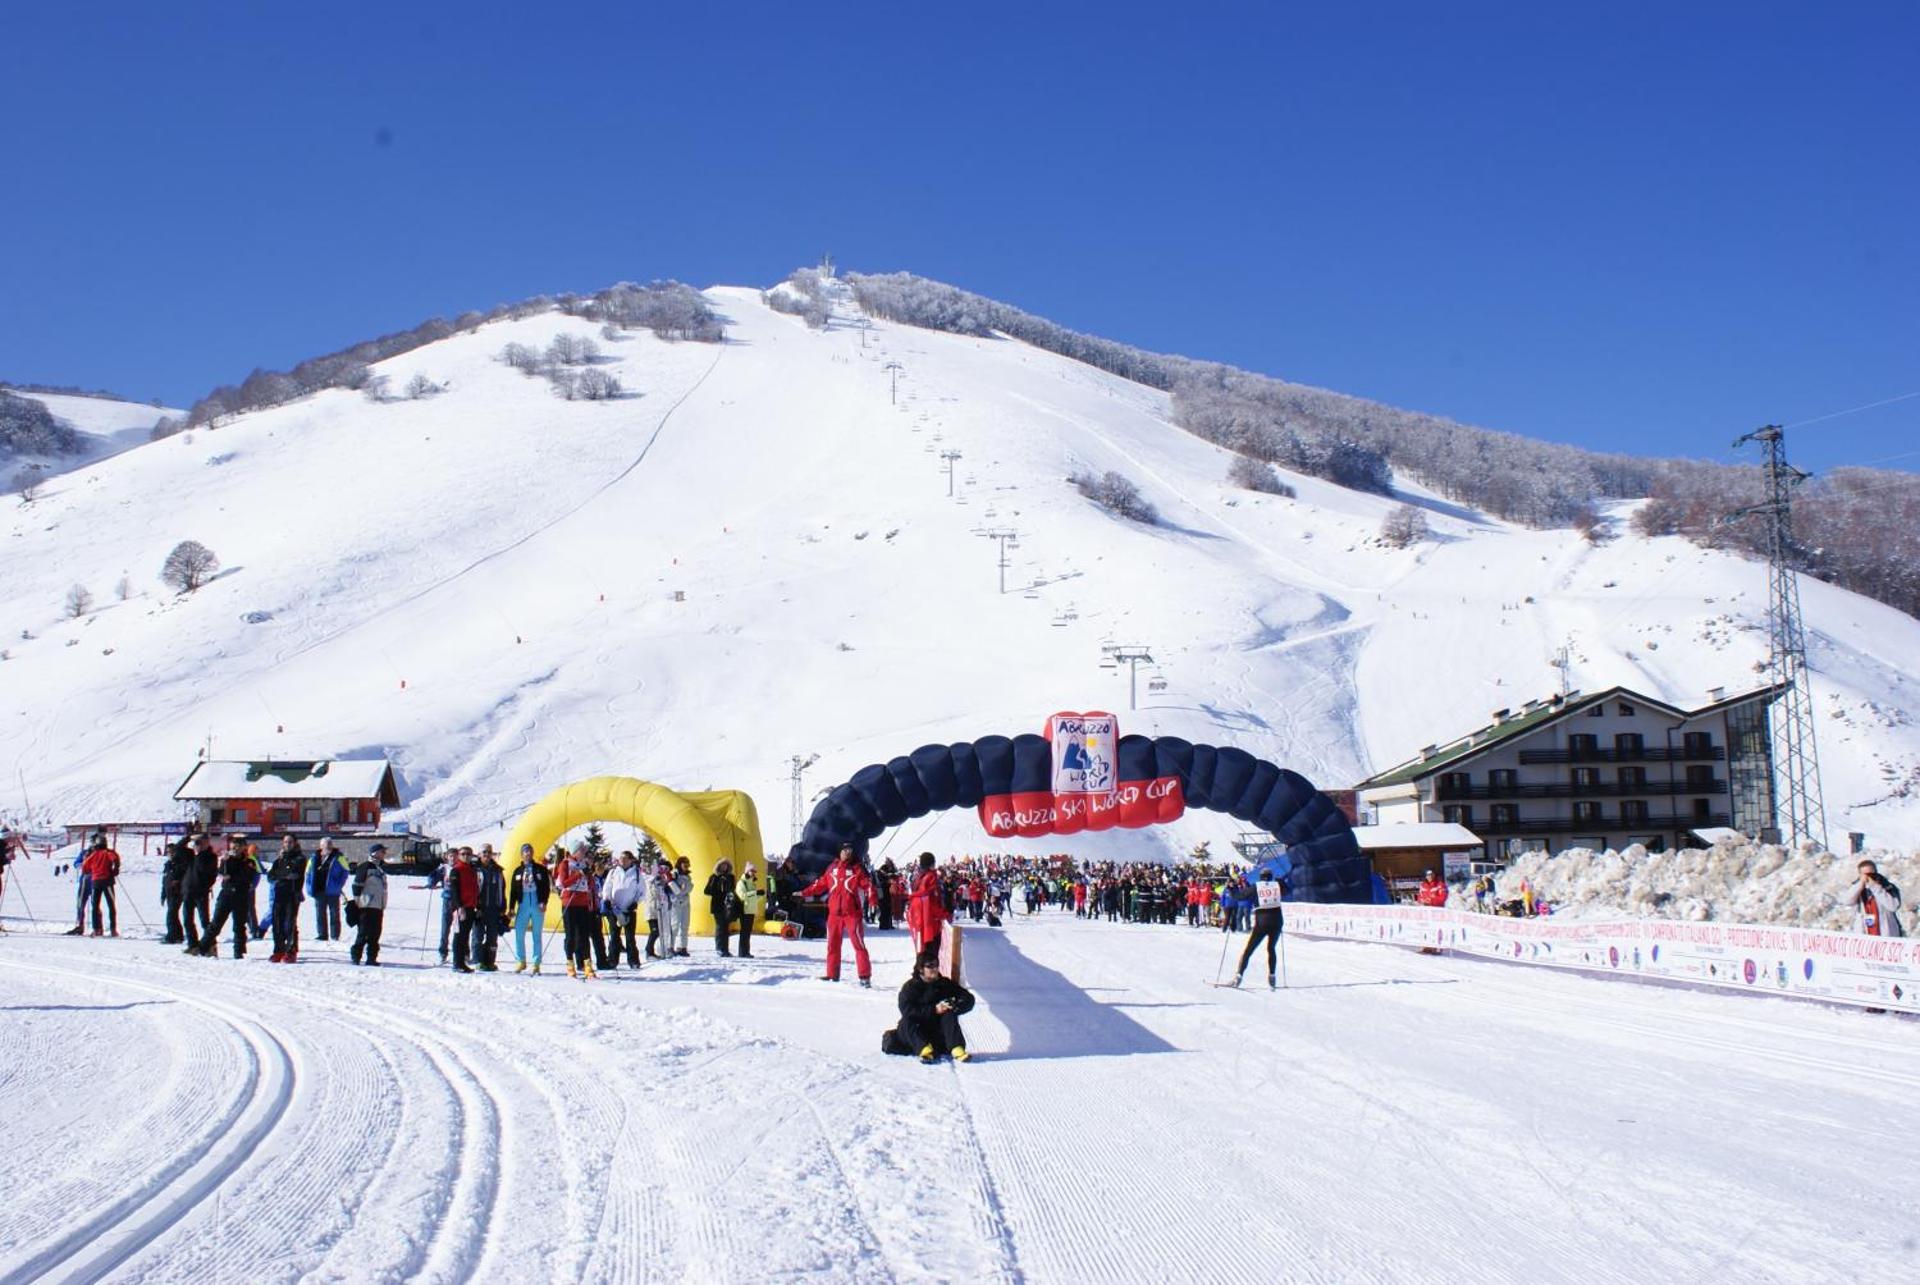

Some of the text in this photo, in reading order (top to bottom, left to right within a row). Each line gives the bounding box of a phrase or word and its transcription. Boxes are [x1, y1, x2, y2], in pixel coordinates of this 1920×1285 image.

[1058, 720, 1110, 735] ABRUZZO
[1069, 761, 1110, 782] WORLD
[991, 778, 1177, 830] ABRUZZO SKI WORLD CUP
